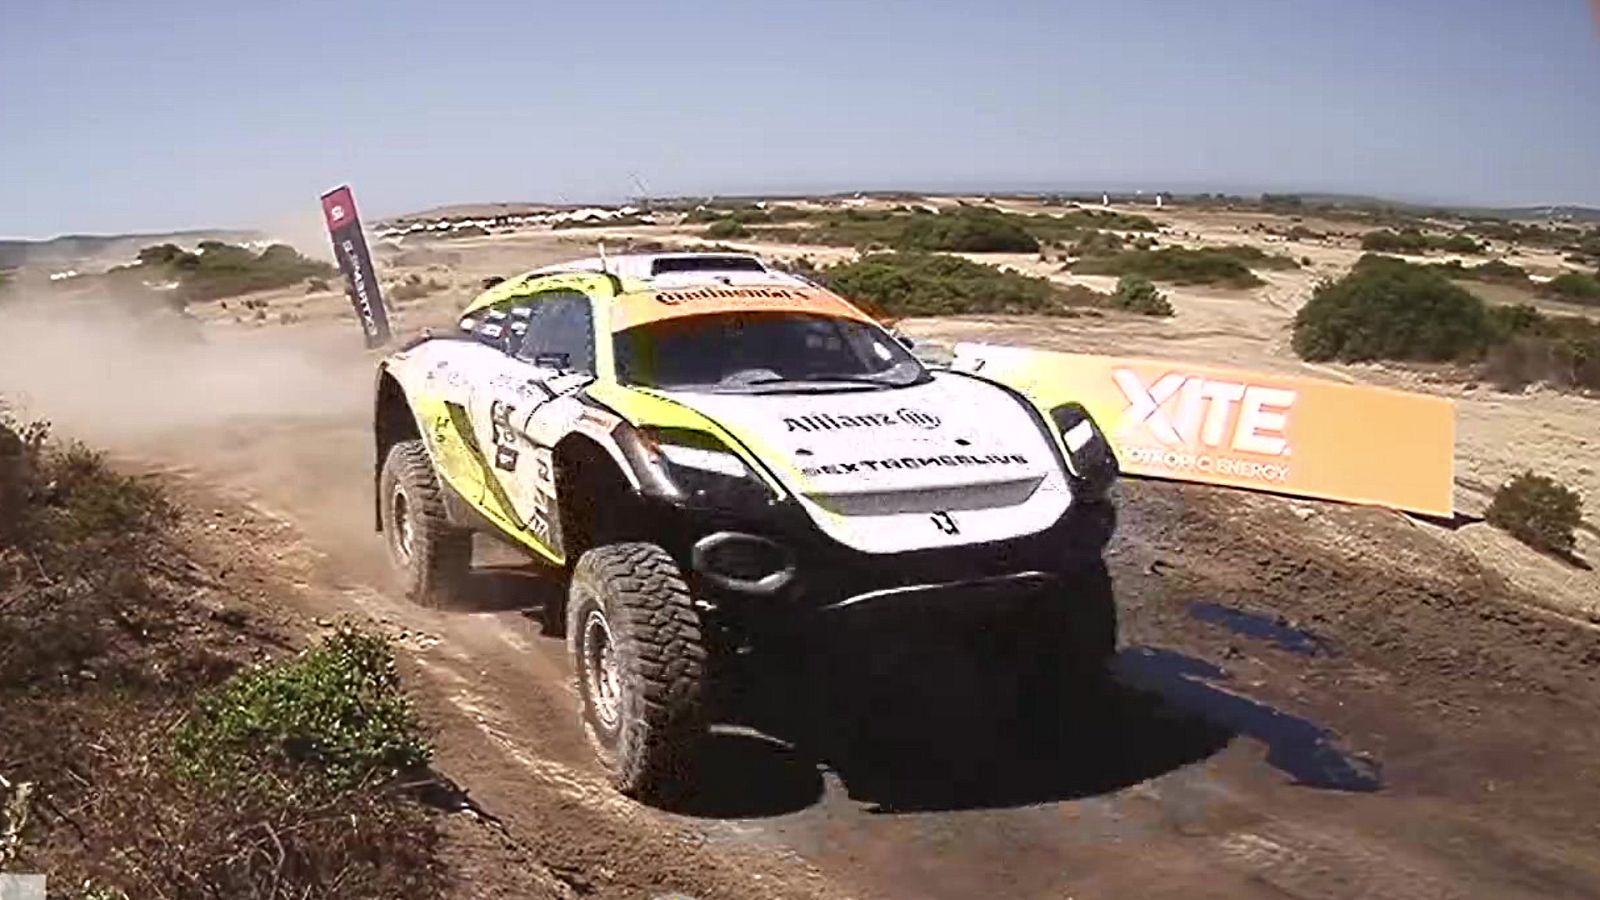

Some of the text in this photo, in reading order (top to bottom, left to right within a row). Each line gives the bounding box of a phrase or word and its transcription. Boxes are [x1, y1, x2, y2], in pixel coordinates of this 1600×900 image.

[783, 413, 896, 432] Allianz
[1112, 368, 1296, 455] XITE
[1216, 459, 1290, 481] ENERGY
